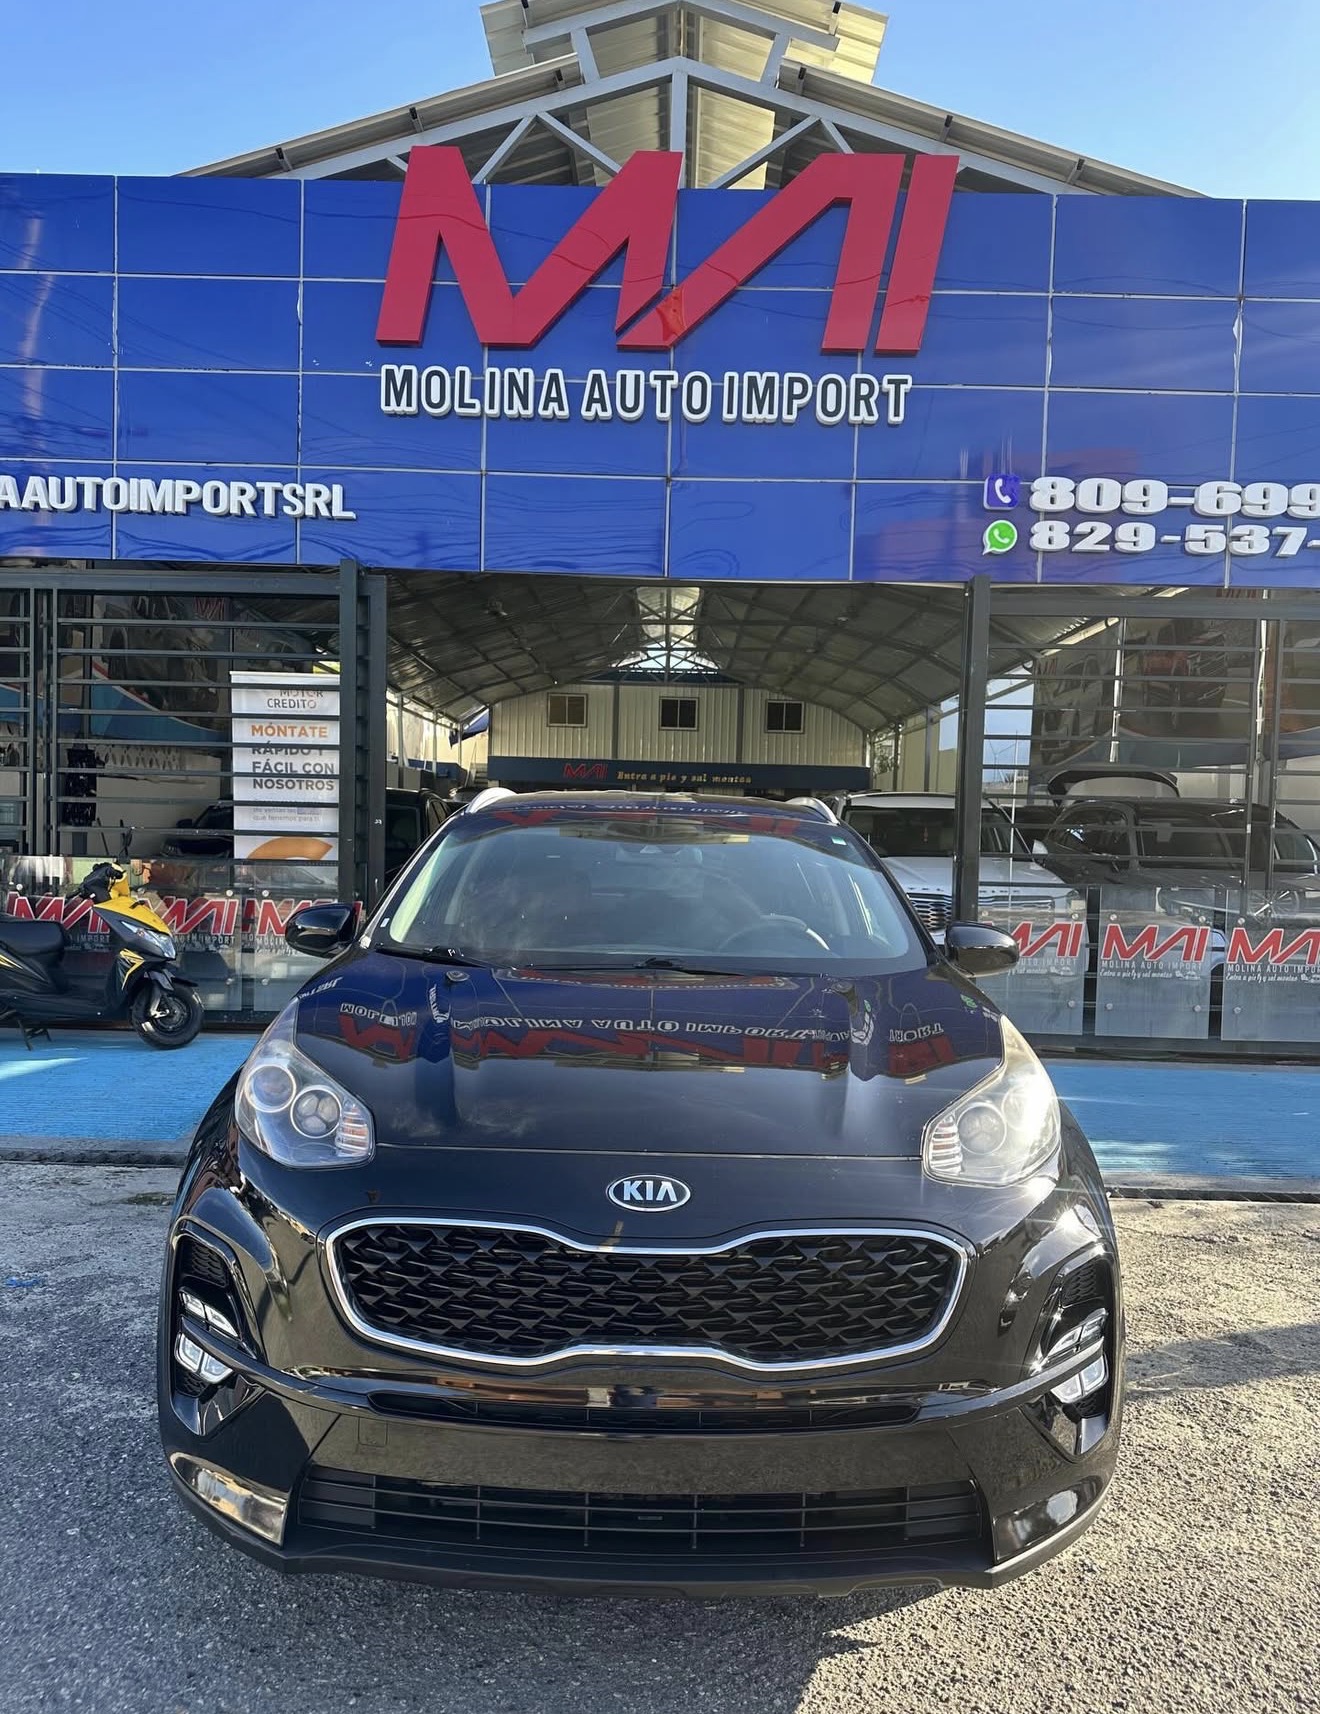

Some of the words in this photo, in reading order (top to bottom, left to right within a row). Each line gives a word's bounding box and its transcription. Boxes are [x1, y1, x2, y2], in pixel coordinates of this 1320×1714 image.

[376, 146, 960, 354] MAI
[380, 365, 569, 419] MOLINA
[582, 370, 711, 423] AUTO
[722, 372, 912, 425] IMPORT
[267, 698, 317, 709] CREDITO
[251, 723, 328, 738] MÓNTATE
[252, 759, 298, 773] FÁCIL
[302, 763, 334, 773] CON
[253, 779, 334, 791] NOSOTROS
[1101, 924, 1210, 962] MAI
[1226, 927, 1320, 966] MA
[1102, 960, 1136, 969] MOLINA
[1141, 961, 1164, 970] AUTO
[1168, 961, 1202, 970] IMPORT
[1227, 964, 1262, 973] MOLINA
[1266, 964, 1289, 973] AUTO
[623, 1180, 678, 1202] KIA
